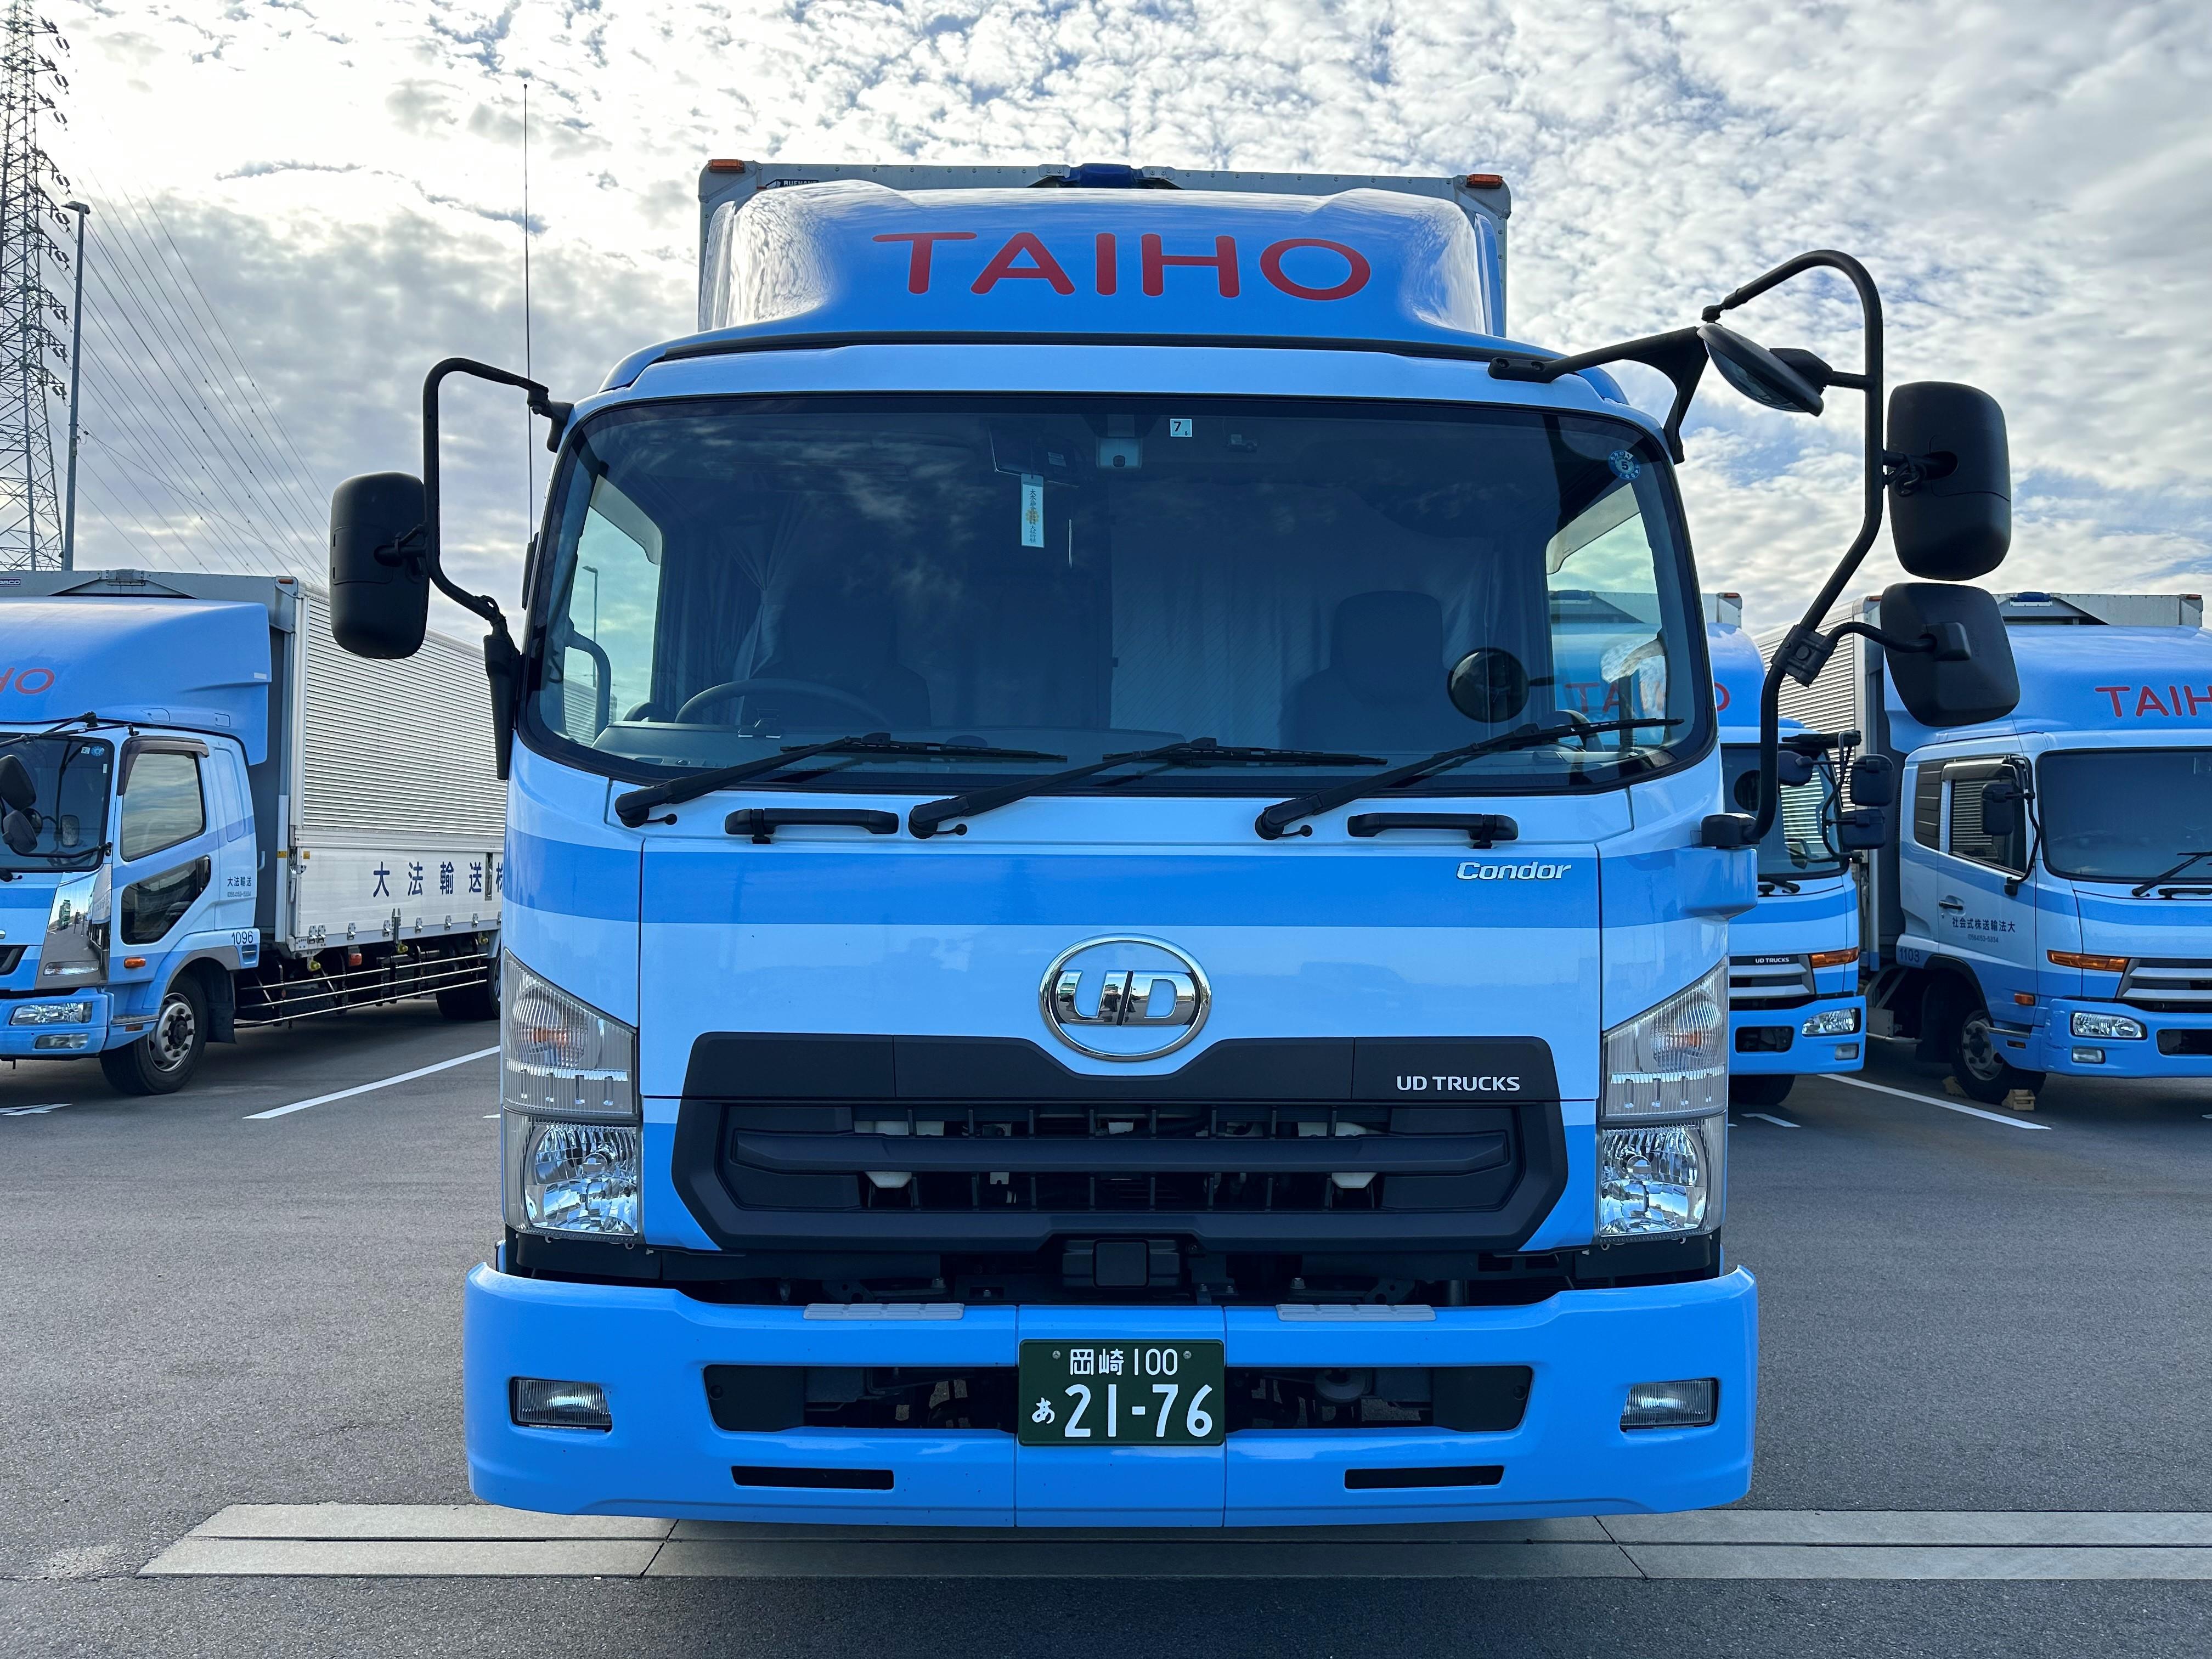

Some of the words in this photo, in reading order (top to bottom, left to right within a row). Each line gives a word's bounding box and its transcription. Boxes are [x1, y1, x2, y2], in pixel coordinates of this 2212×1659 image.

[872, 232, 1372, 301] TAIHO
[1173, 421, 1182, 432] 7
[1621, 460, 1629, 470] 5
[2095, 685, 2212, 718] TAIH
[1457, 861, 1572, 879] Condor
[227, 877, 251, 887] 大法輸送
[232, 930, 253, 945] 1096
[1900, 947, 1920, 963] 1103
[1054, 970, 1196, 1026] UD
[1397, 1075, 1427, 1091] UD
[1432, 1076, 1521, 1092] TRUCKS
[1070, 1348, 1124, 1376] 岡崎
[1134, 1348, 1178, 1375] 100
[1031, 1397, 1056, 1424] あ
[1064, 1384, 1213, 1437] 21-76
